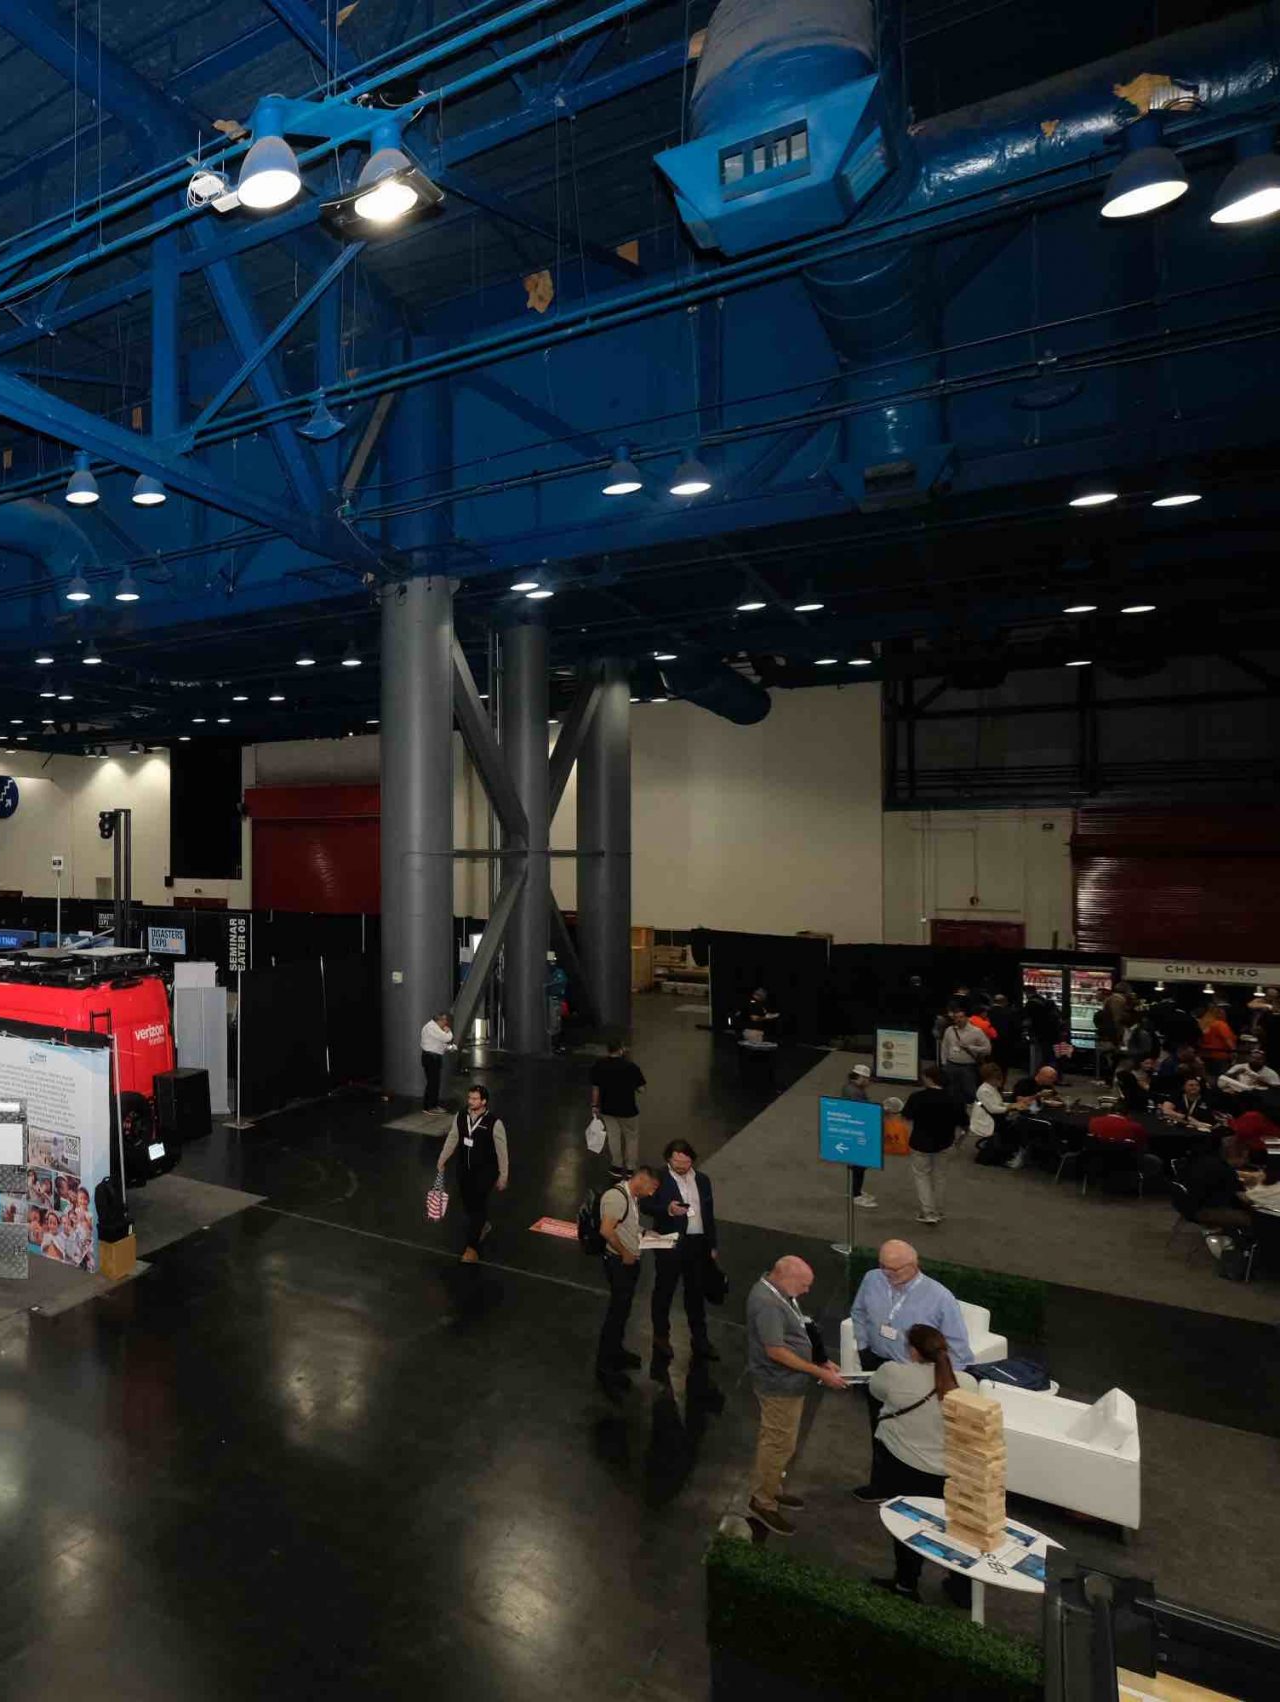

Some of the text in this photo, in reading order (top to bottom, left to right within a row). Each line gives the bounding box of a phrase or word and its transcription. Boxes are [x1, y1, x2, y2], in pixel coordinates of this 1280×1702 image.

[151, 928, 183, 939] DISASTERS
[151, 939, 167, 947] EXPO
[229, 918, 238, 971] SEMINAR
[135, 1024, 165, 1041] verizon
